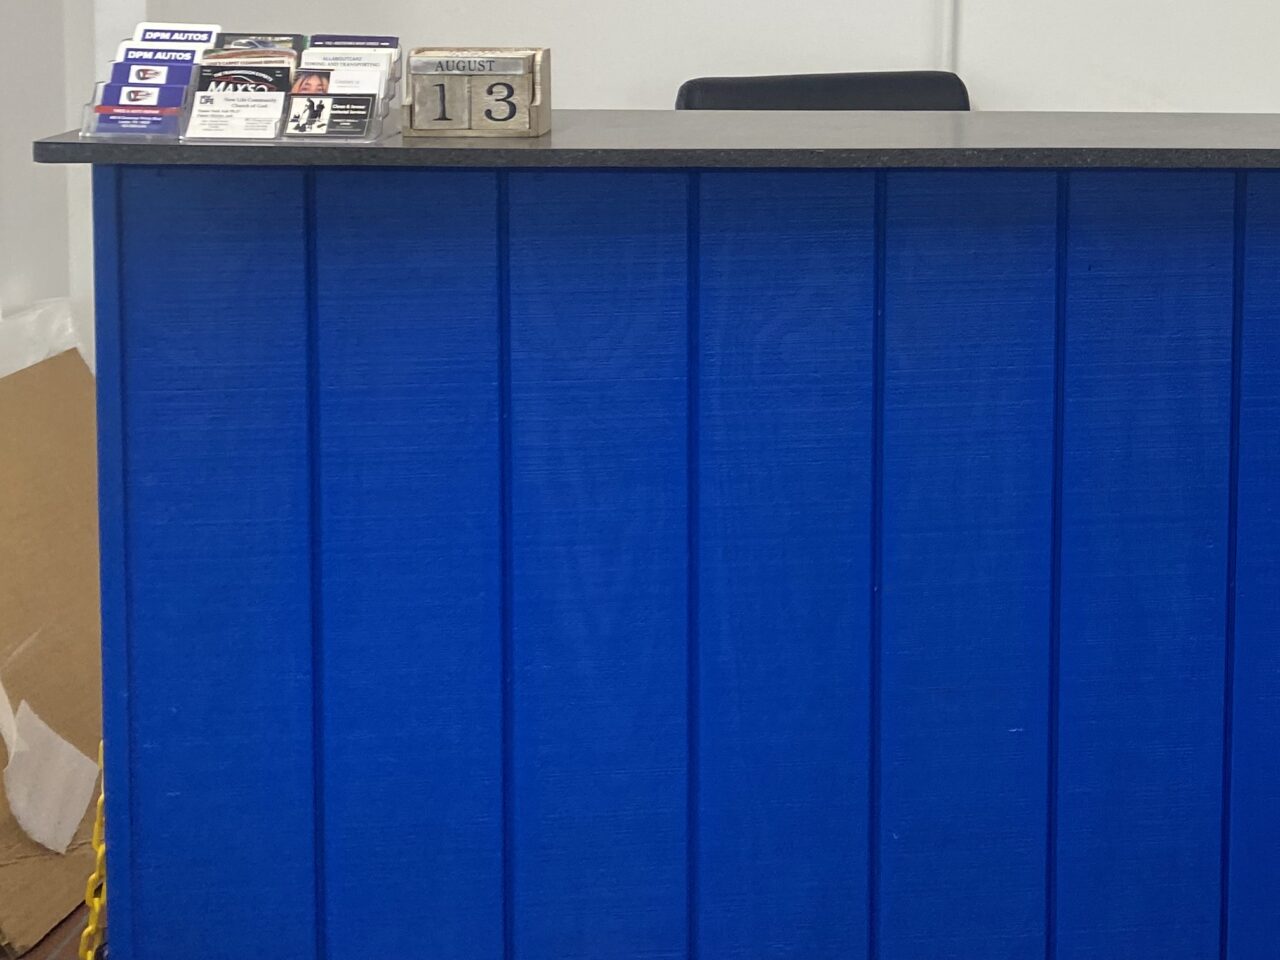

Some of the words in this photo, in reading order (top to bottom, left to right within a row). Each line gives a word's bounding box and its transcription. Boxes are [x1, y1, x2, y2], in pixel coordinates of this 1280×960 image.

[144, 31, 170, 40] DPM
[171, 32, 209, 41] AUTOS
[127, 50, 153, 59] DPM
[154, 51, 192, 60] AUTOS
[434, 60, 496, 72] AUGUST
[432, 83, 453, 121] 1
[484, 82, 517, 122] 3
